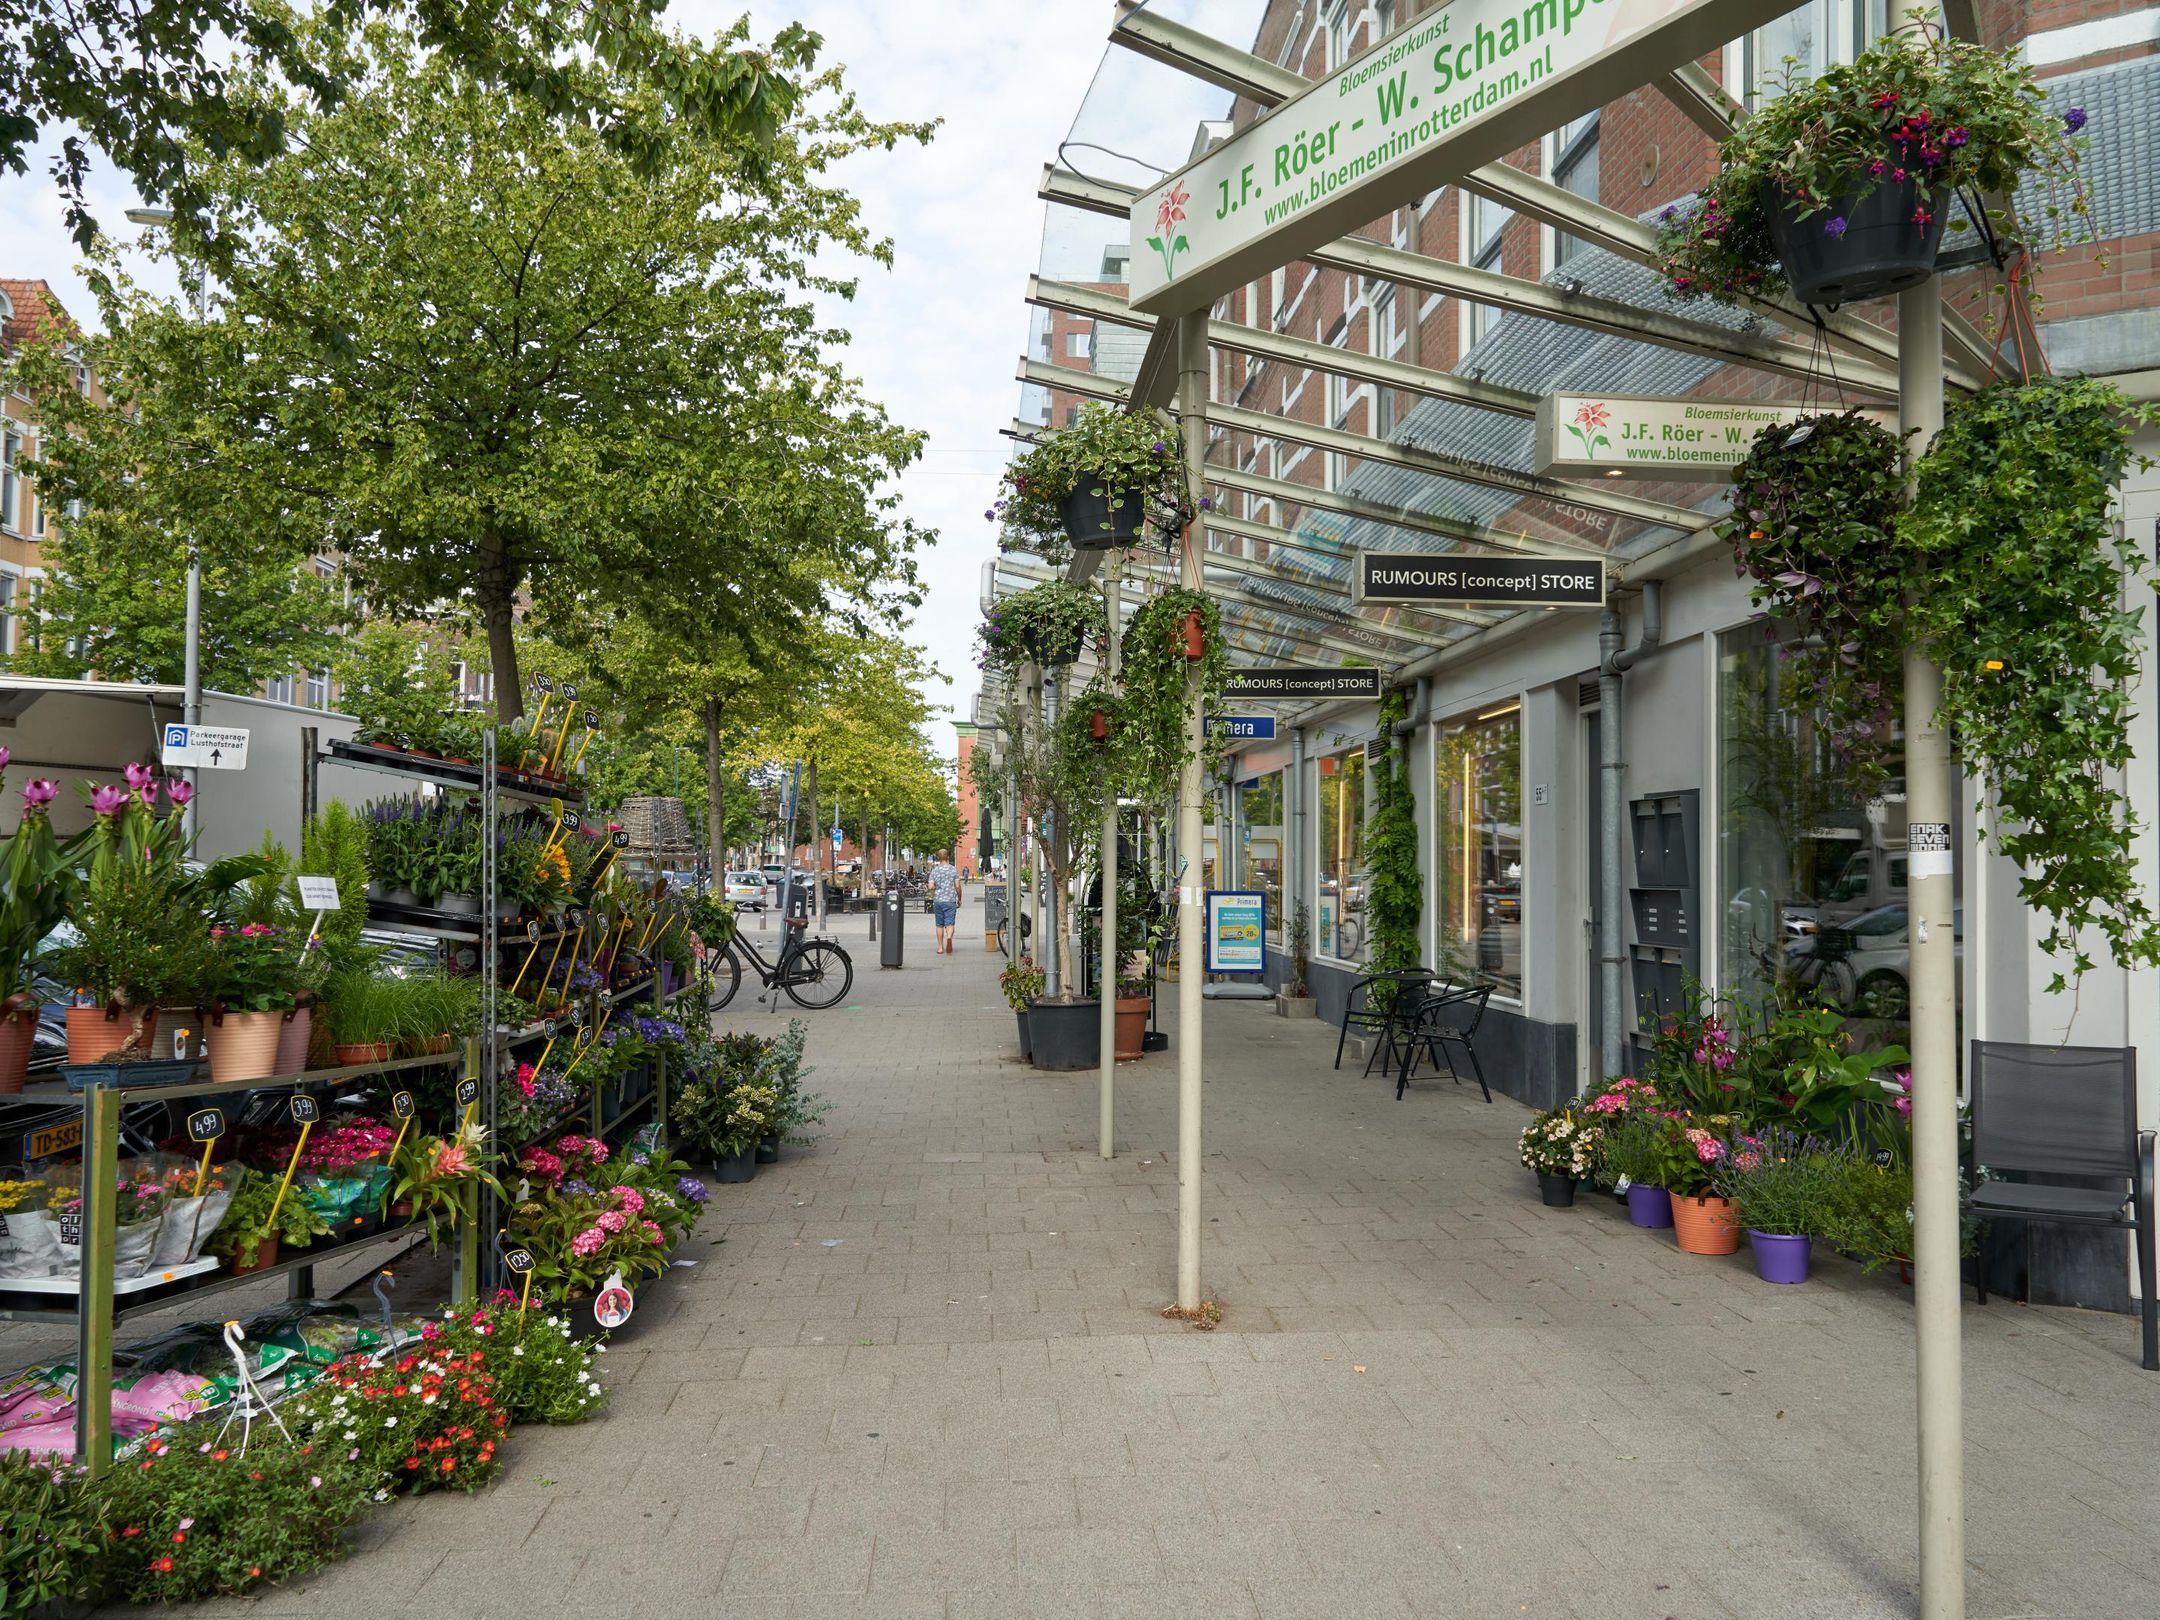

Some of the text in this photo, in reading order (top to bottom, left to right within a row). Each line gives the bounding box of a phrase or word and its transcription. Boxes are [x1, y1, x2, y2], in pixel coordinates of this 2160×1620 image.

[1338, 13, 1450, 98] Bloemsierkunst
[1216, 163, 1262, 220] J.F.
[1274, 120, 1341, 188] Röer
[1377, 70, 1419, 126] W.
[1433, 0, 1606, 95] Schamp
[1264, 44, 1554, 227] www.bloemeninrotterdam.nl
[1685, 406, 1782, 422] Bloemsierkunst
[1621, 422, 1654, 441] J.F.
[1662, 424, 1704, 442] Röer
[1725, 426, 1748, 444] W.
[1371, 569, 1595, 592] RUMOURS [concept] STORE
[1226, 678, 1374, 691] RUMOURS [concept] STORE
[190, 730, 246, 742] Parkeergarage
[190, 739, 244, 749] Lusthofstraat
[1910, 834, 1949, 844] SEVEN
